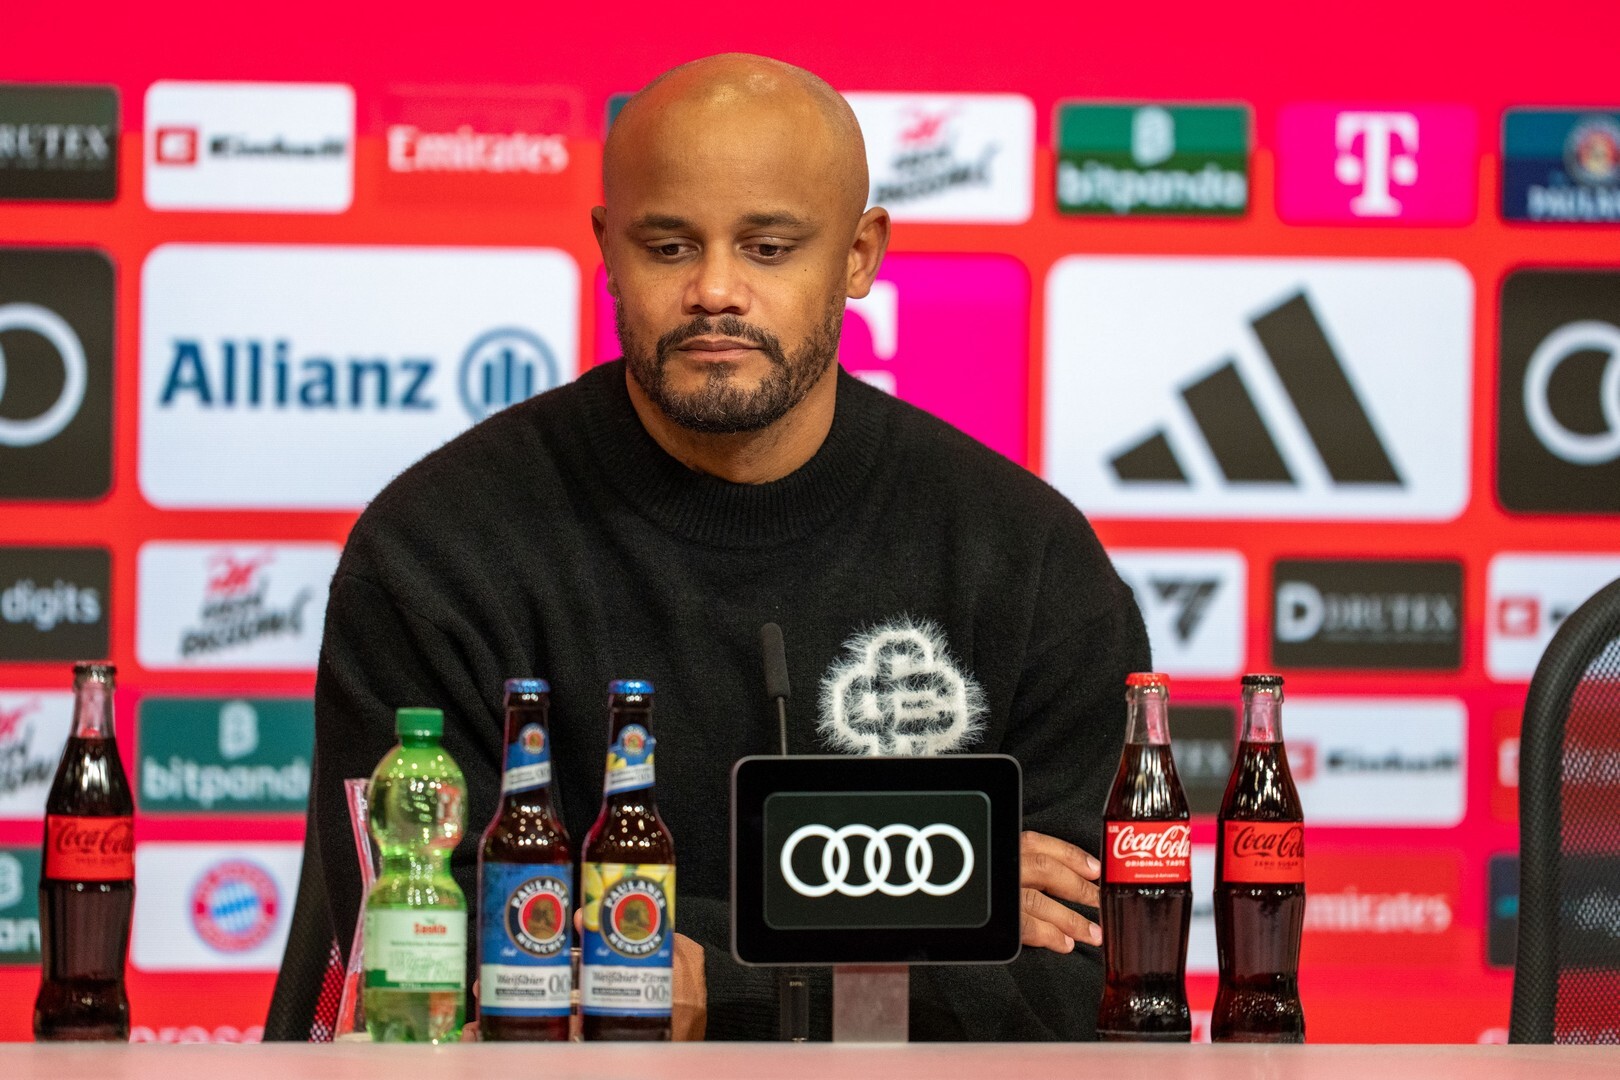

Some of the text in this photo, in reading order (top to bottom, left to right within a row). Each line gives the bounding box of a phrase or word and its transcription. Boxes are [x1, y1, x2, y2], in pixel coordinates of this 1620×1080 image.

[388, 125, 569, 174] Emirates
[1335, 111, 1418, 217] T
[1059, 160, 1247, 213] bitpanda
[160, 338, 435, 409] Allianz
[2, 580, 99, 630] digits
[144, 760, 309, 807] bitpand
[1304, 888, 1451, 932] mirates
